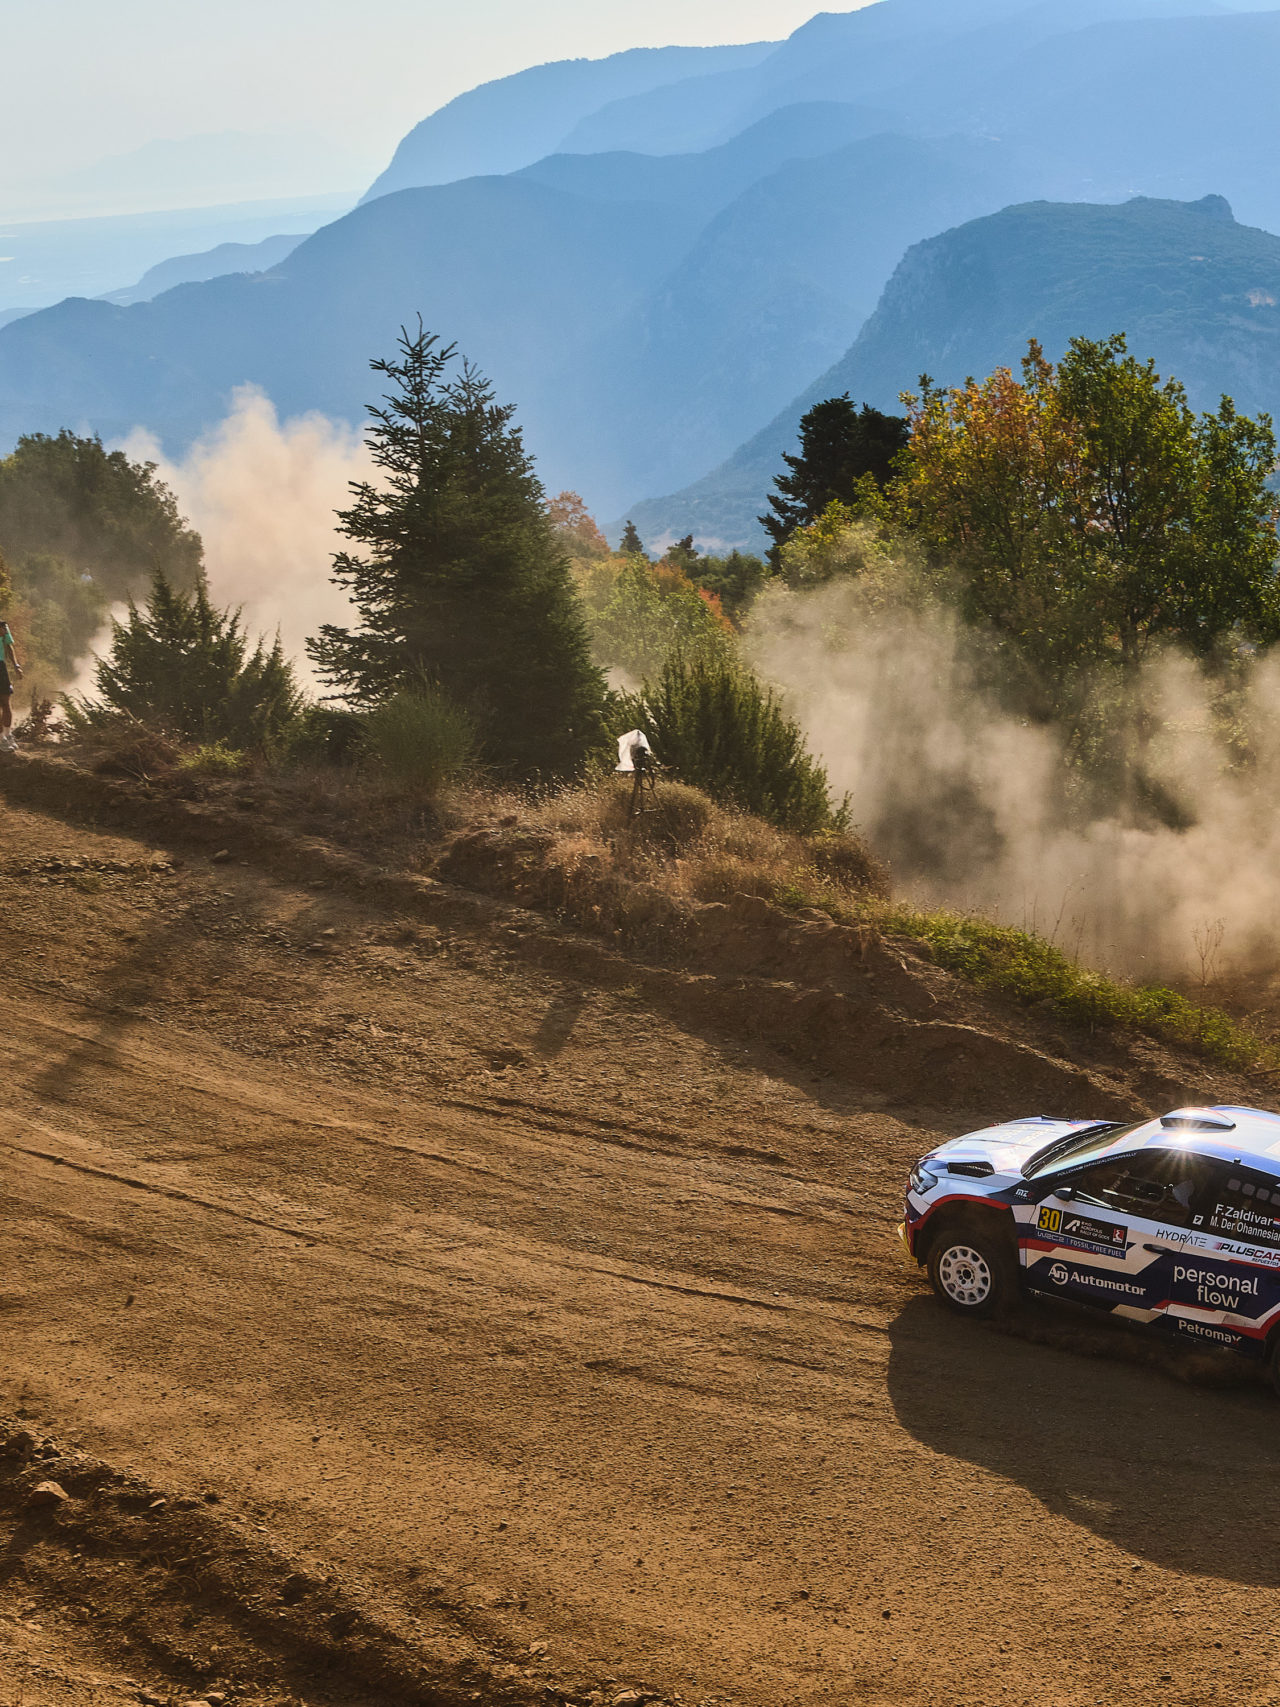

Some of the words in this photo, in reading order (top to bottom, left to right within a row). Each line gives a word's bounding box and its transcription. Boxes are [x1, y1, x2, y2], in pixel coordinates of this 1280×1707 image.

[1040, 1207, 1060, 1231] 30
[1215, 1204, 1274, 1226] F.Zaldivar
[1221, 1218, 1235, 1230] Der
[1070, 1239, 1107, 1254] FOSSIL-FREE
[1108, 1249, 1123, 1257] FUEL
[1156, 1229, 1207, 1247] HYDRATE
[1070, 1271, 1146, 1295] Automotor
[1174, 1265, 1258, 1295] personal
[1197, 1285, 1239, 1308] flow
